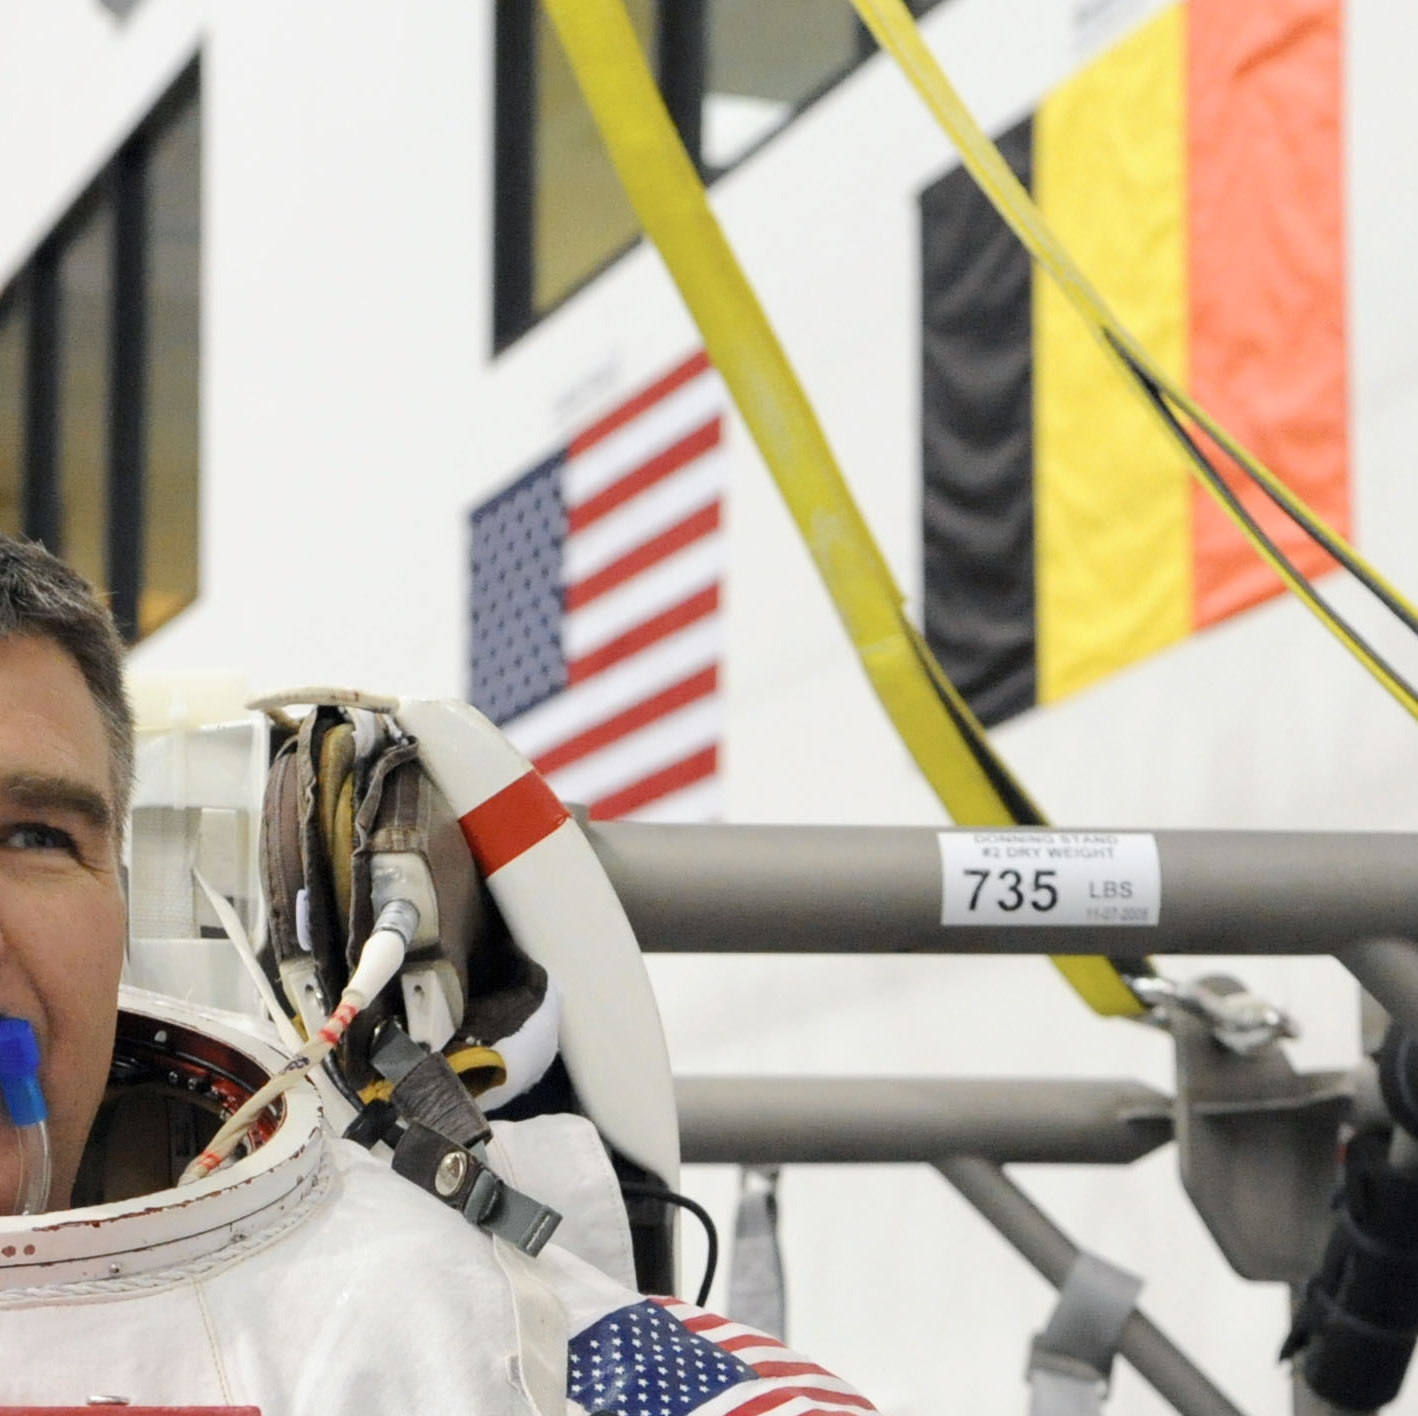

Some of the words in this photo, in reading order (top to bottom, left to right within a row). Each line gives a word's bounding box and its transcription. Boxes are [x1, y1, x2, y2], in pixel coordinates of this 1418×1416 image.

[1006, 847, 1040, 859] DRY
[1047, 847, 1114, 859] WEIGHT
[963, 869, 1058, 912] 735
[1089, 881, 1133, 899] LBS
